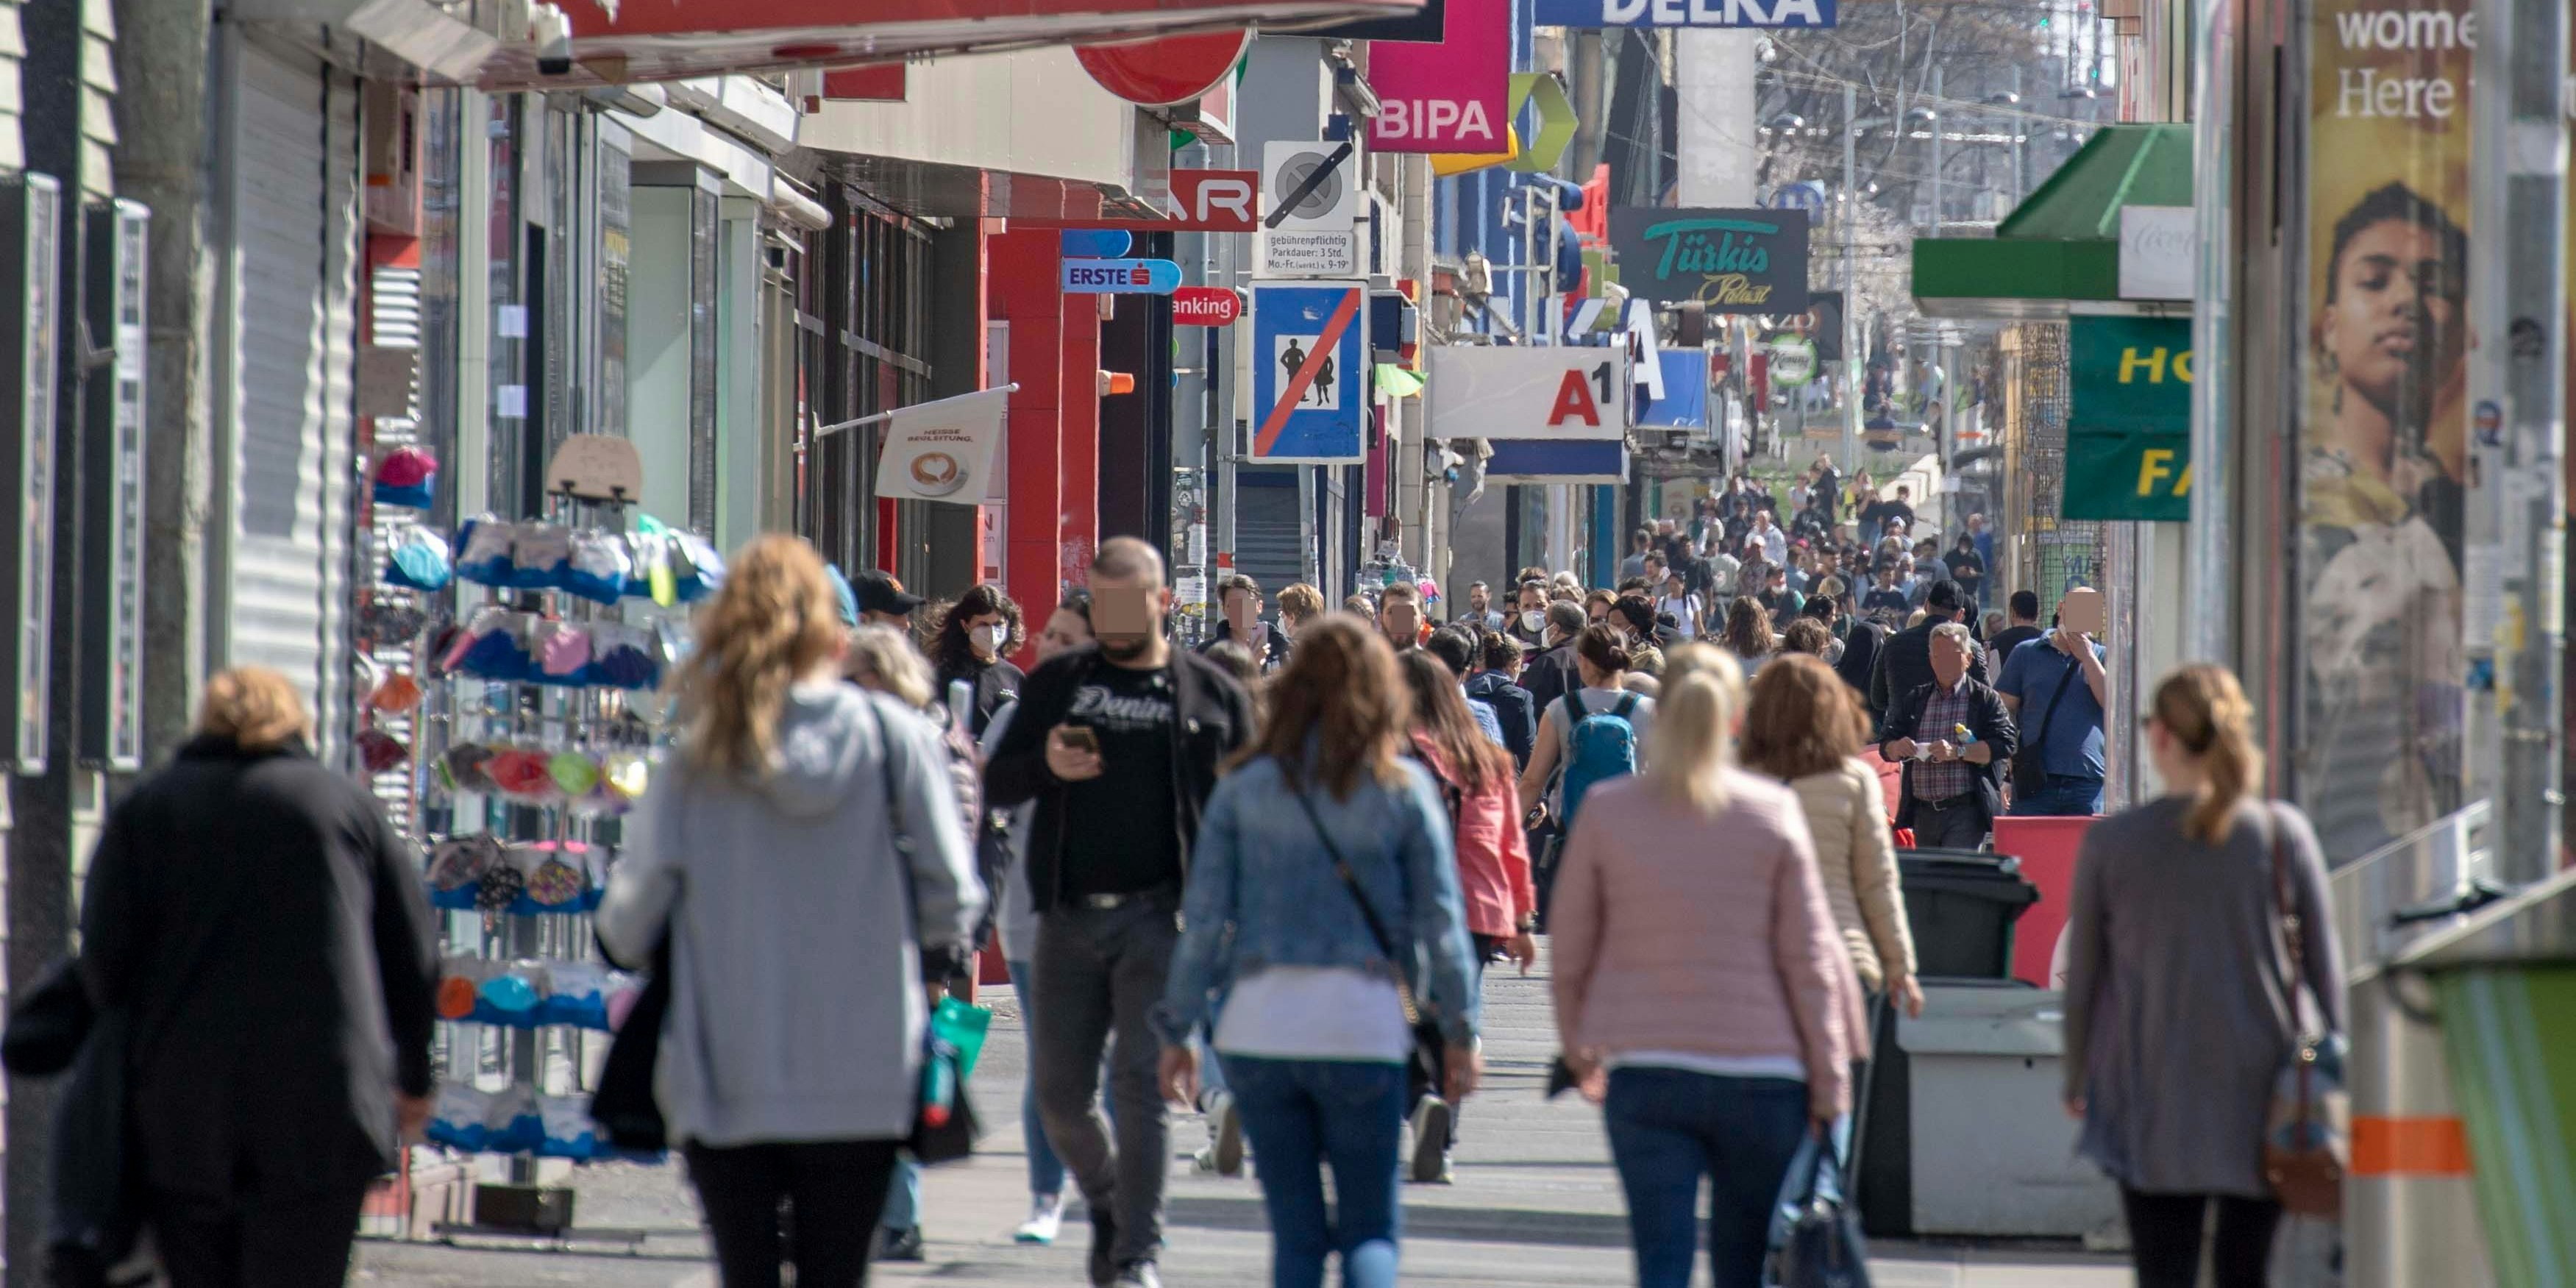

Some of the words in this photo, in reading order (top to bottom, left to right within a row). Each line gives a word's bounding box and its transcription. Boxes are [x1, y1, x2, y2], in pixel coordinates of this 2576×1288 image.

[2335, 68, 2455, 118] Here
[1376, 99, 1494, 139] BIPA
[1270, 235, 1347, 247] gebührenpflichtig
[1273, 248, 1317, 257] Parkdauer:
[1320, 248, 1326, 257] 3
[1328, 248, 1344, 257] Std.
[1643, 218, 1779, 280] Türkis
[1070, 268, 1127, 285] ERSTE
[1548, 361, 1611, 426] A1
